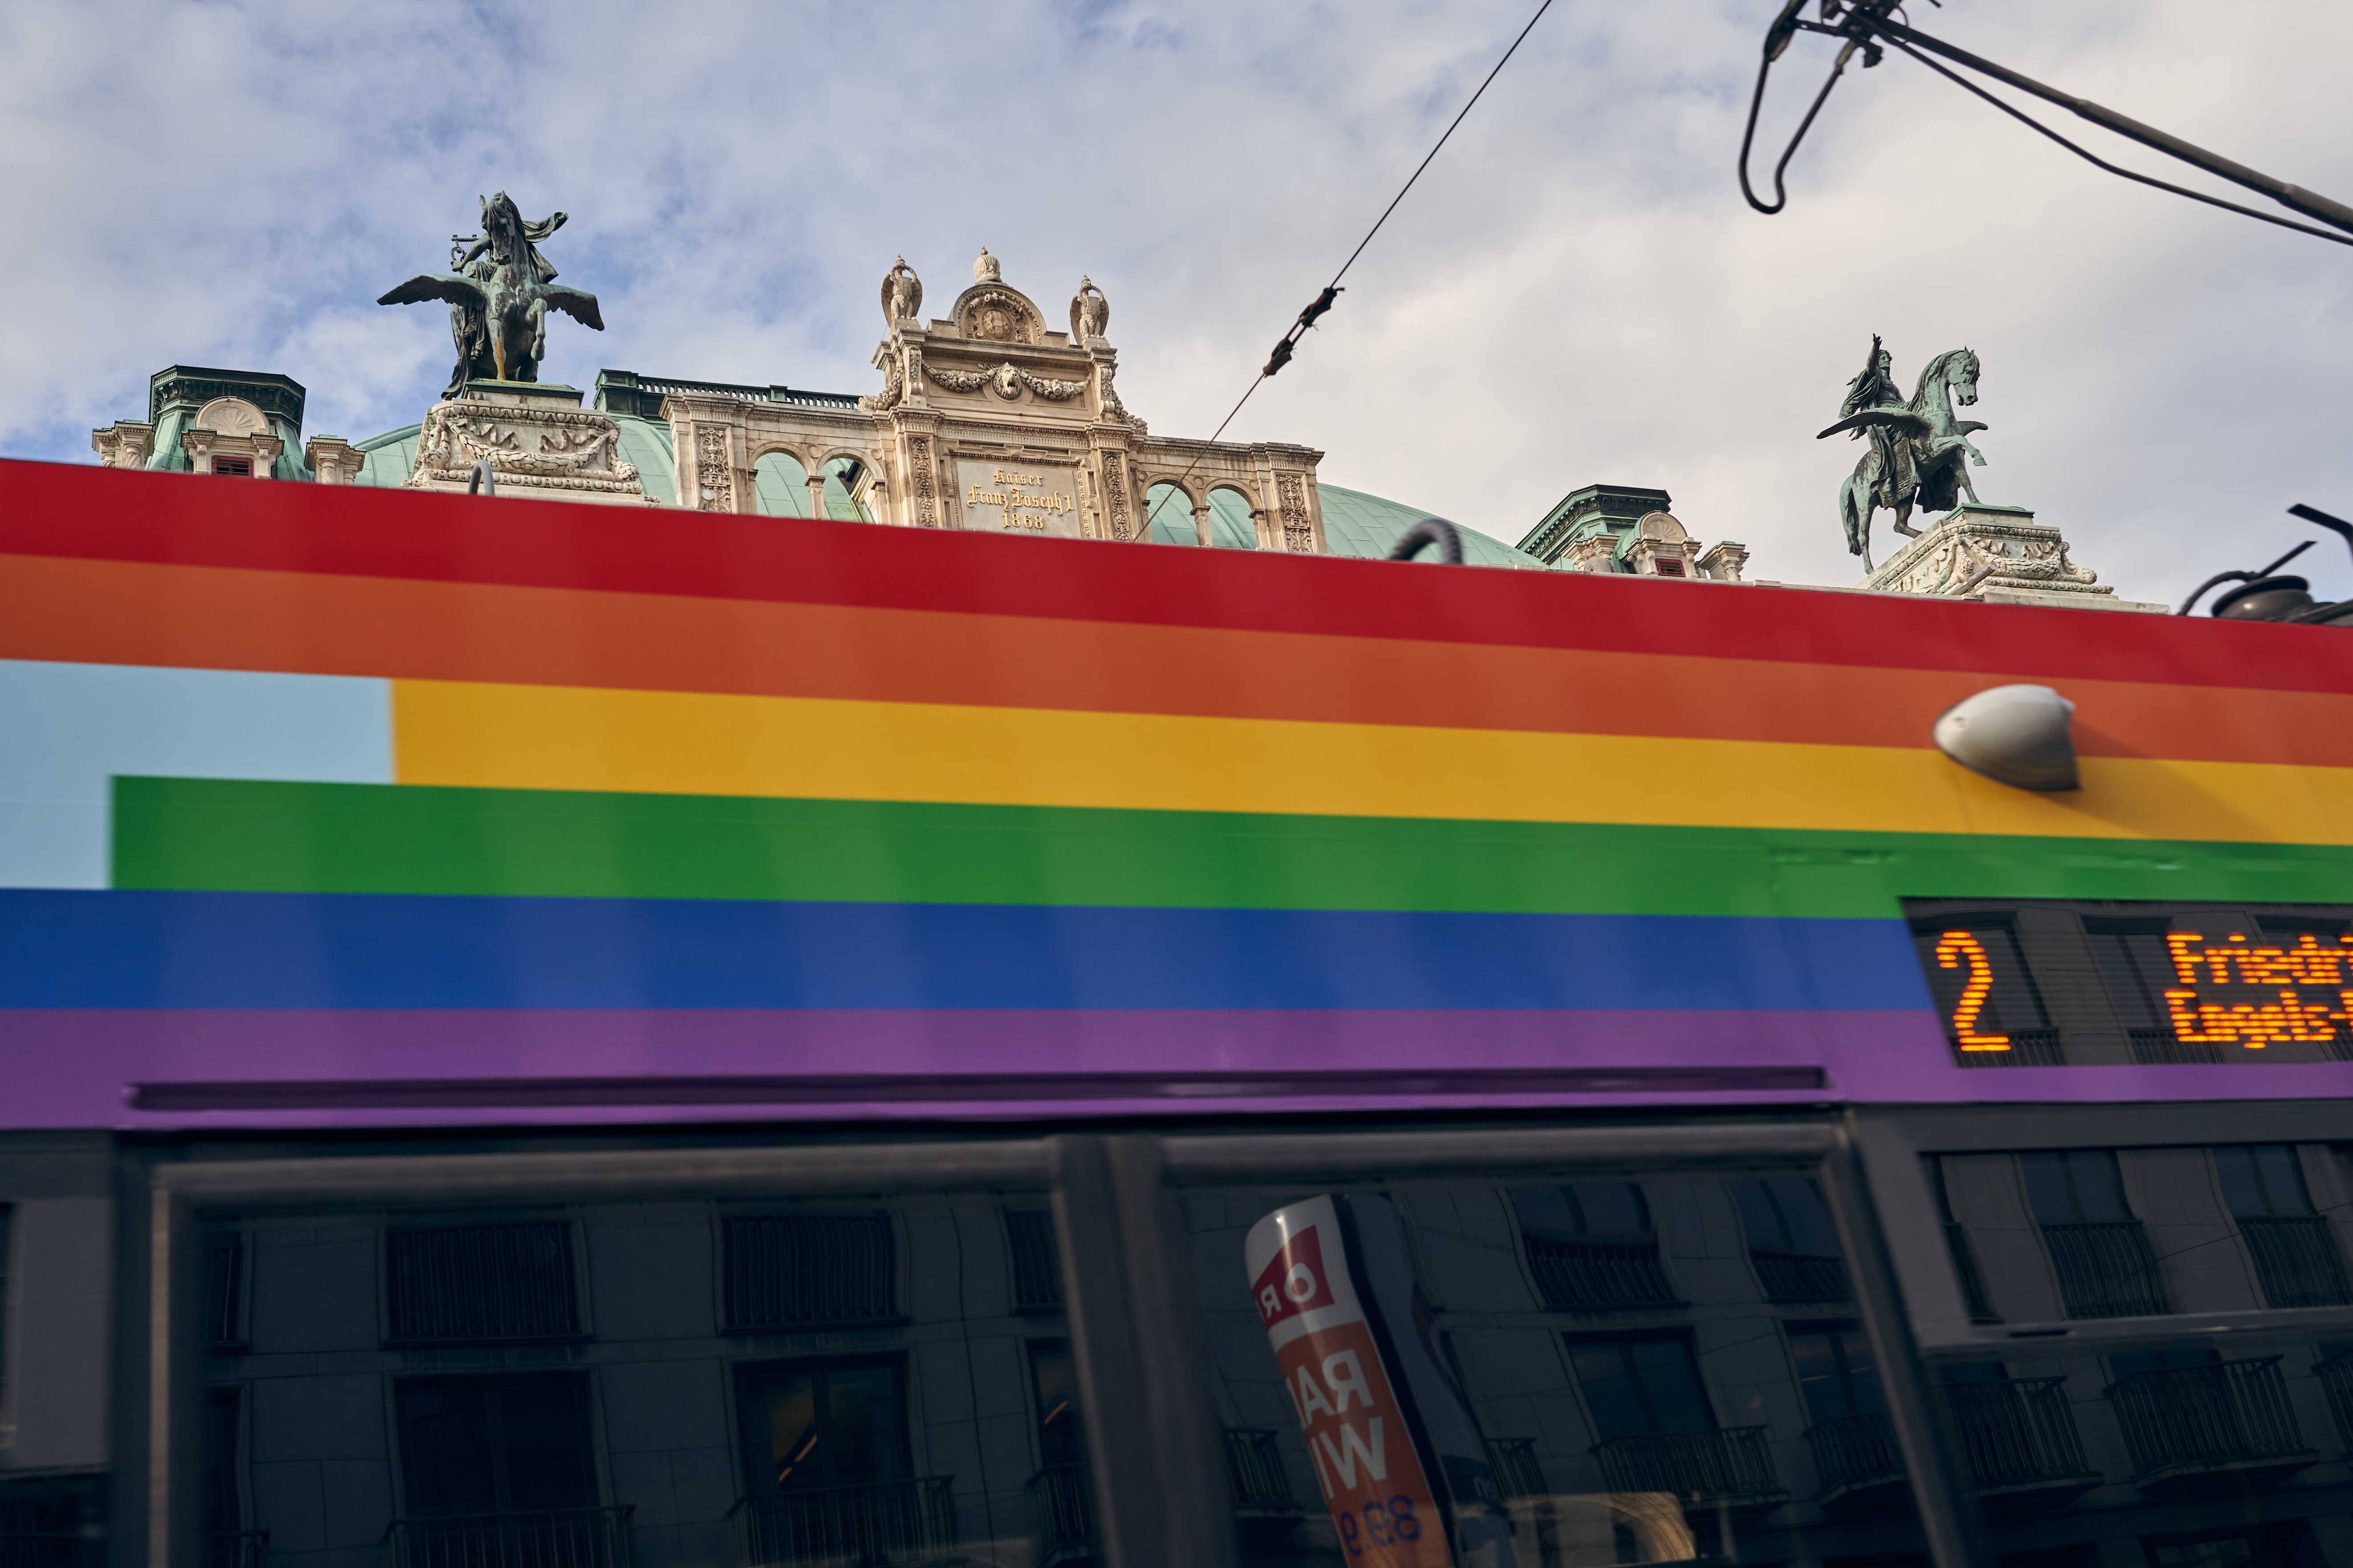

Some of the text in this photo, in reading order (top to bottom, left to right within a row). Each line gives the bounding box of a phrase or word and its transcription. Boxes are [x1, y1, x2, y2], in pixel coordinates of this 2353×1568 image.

[993, 469, 1043, 486] Kaiser
[967, 483, 1008, 512] Franz
[1010, 486, 1063, 515] Joseph
[1002, 513, 1043, 529] 1868
[1936, 933, 2011, 1051] 2
